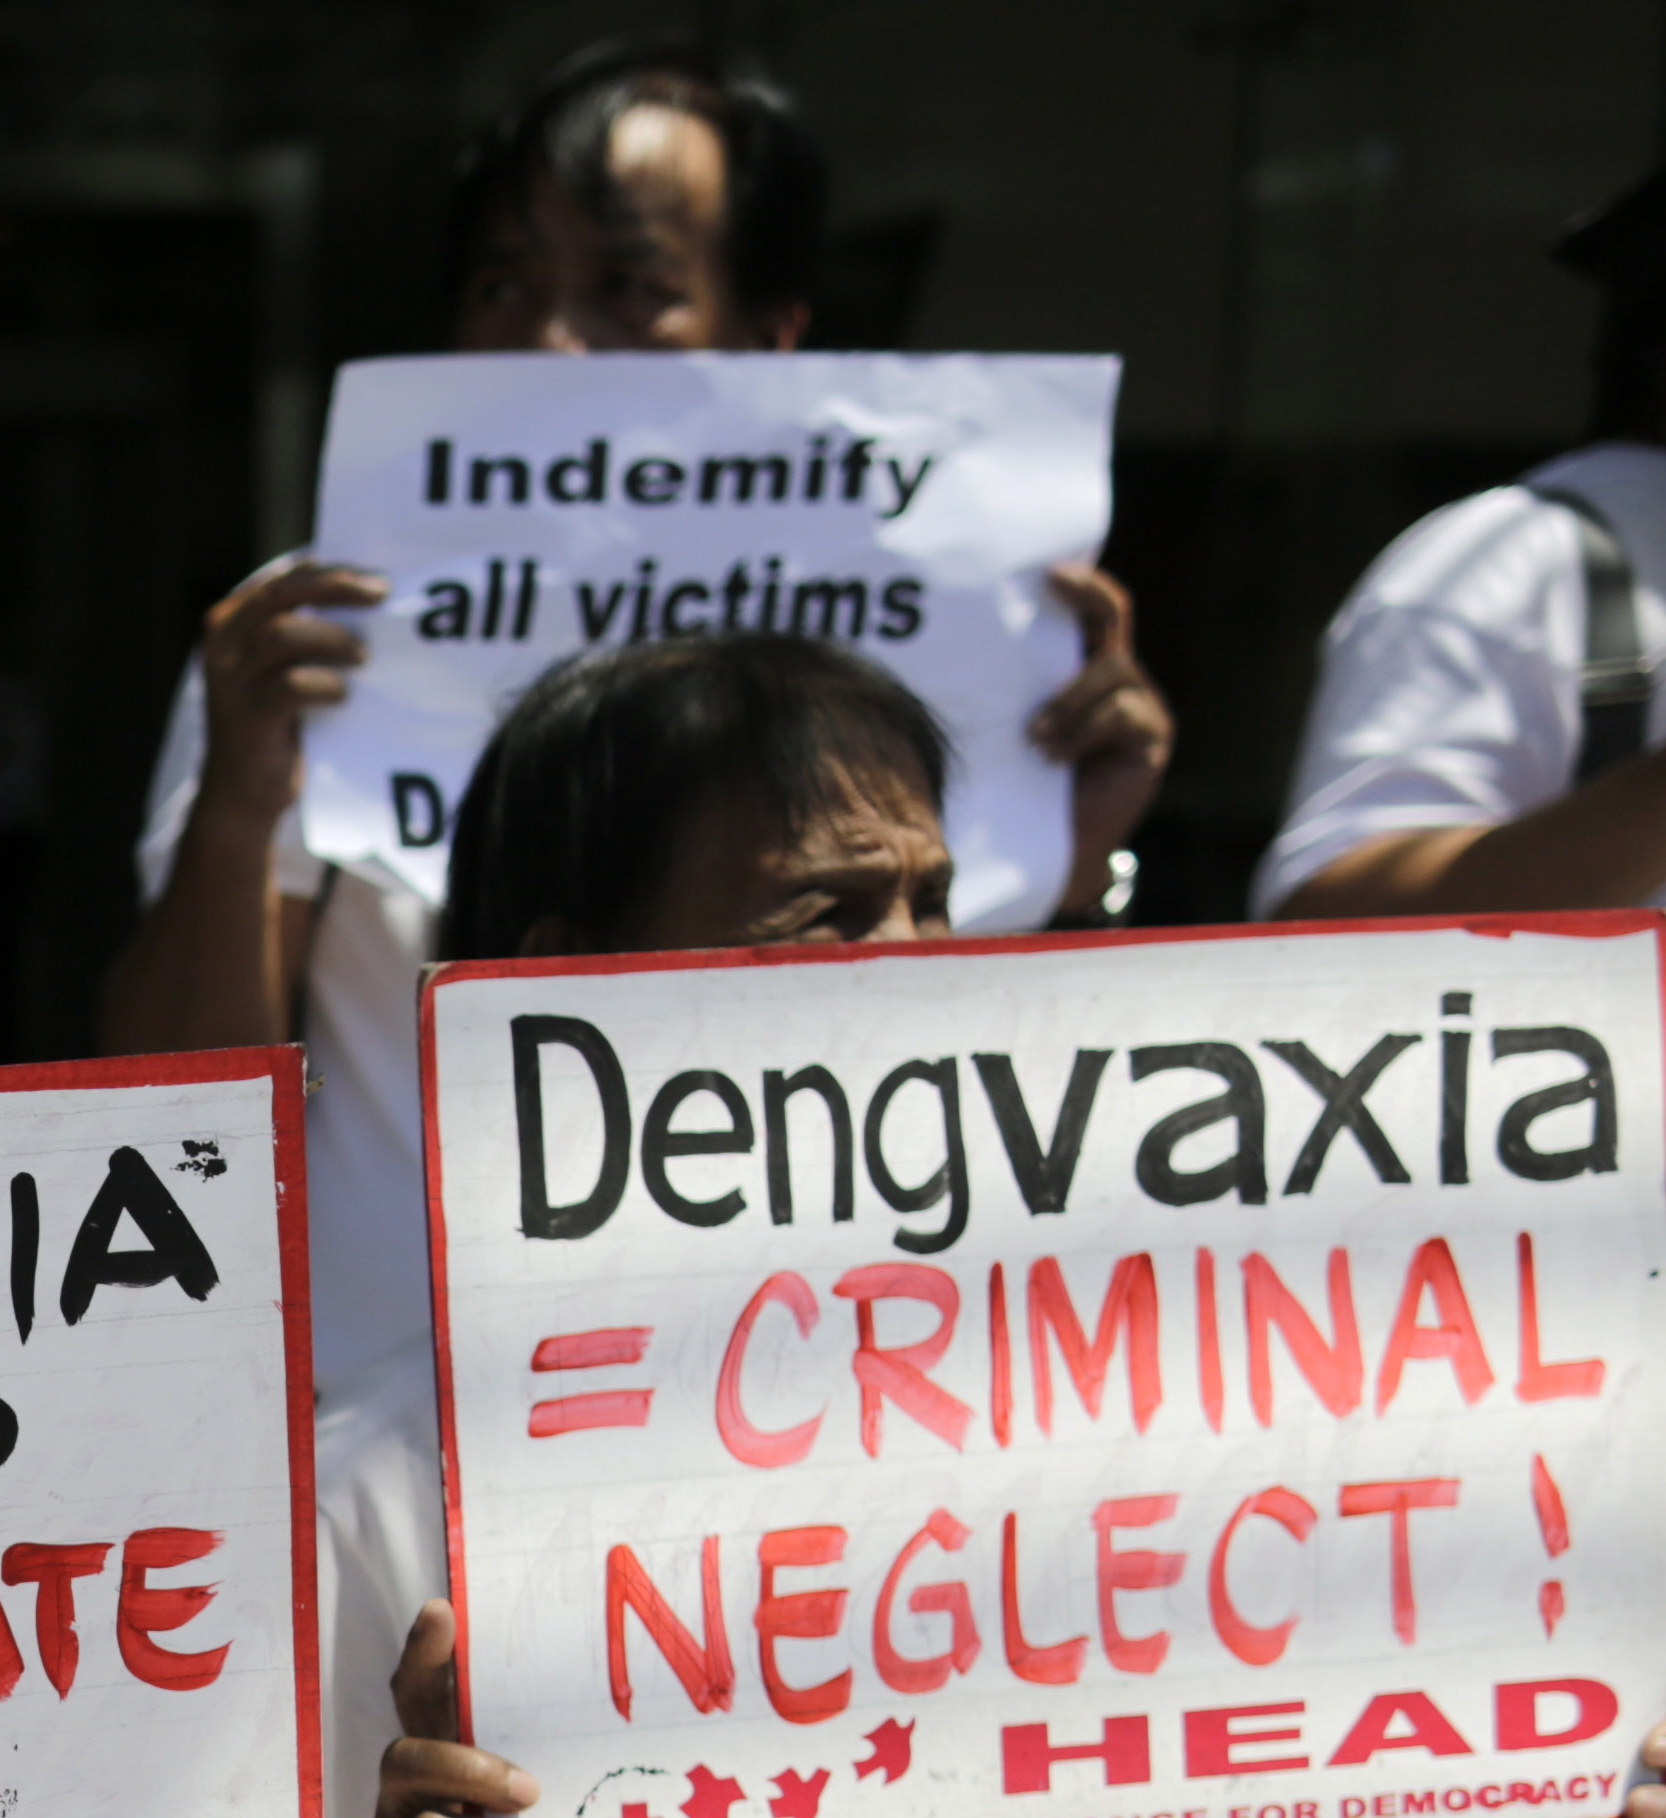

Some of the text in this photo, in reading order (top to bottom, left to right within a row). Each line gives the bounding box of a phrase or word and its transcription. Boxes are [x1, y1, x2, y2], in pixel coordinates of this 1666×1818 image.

[422, 435, 932, 518] Indemify
[416, 556, 926, 643] all victims
[510, 992, 1618, 1255] Dengvaxia
[1000, 1677, 1619, 1796] HEAD
[1338, 1771, 1618, 1816] DEMOCRACY
